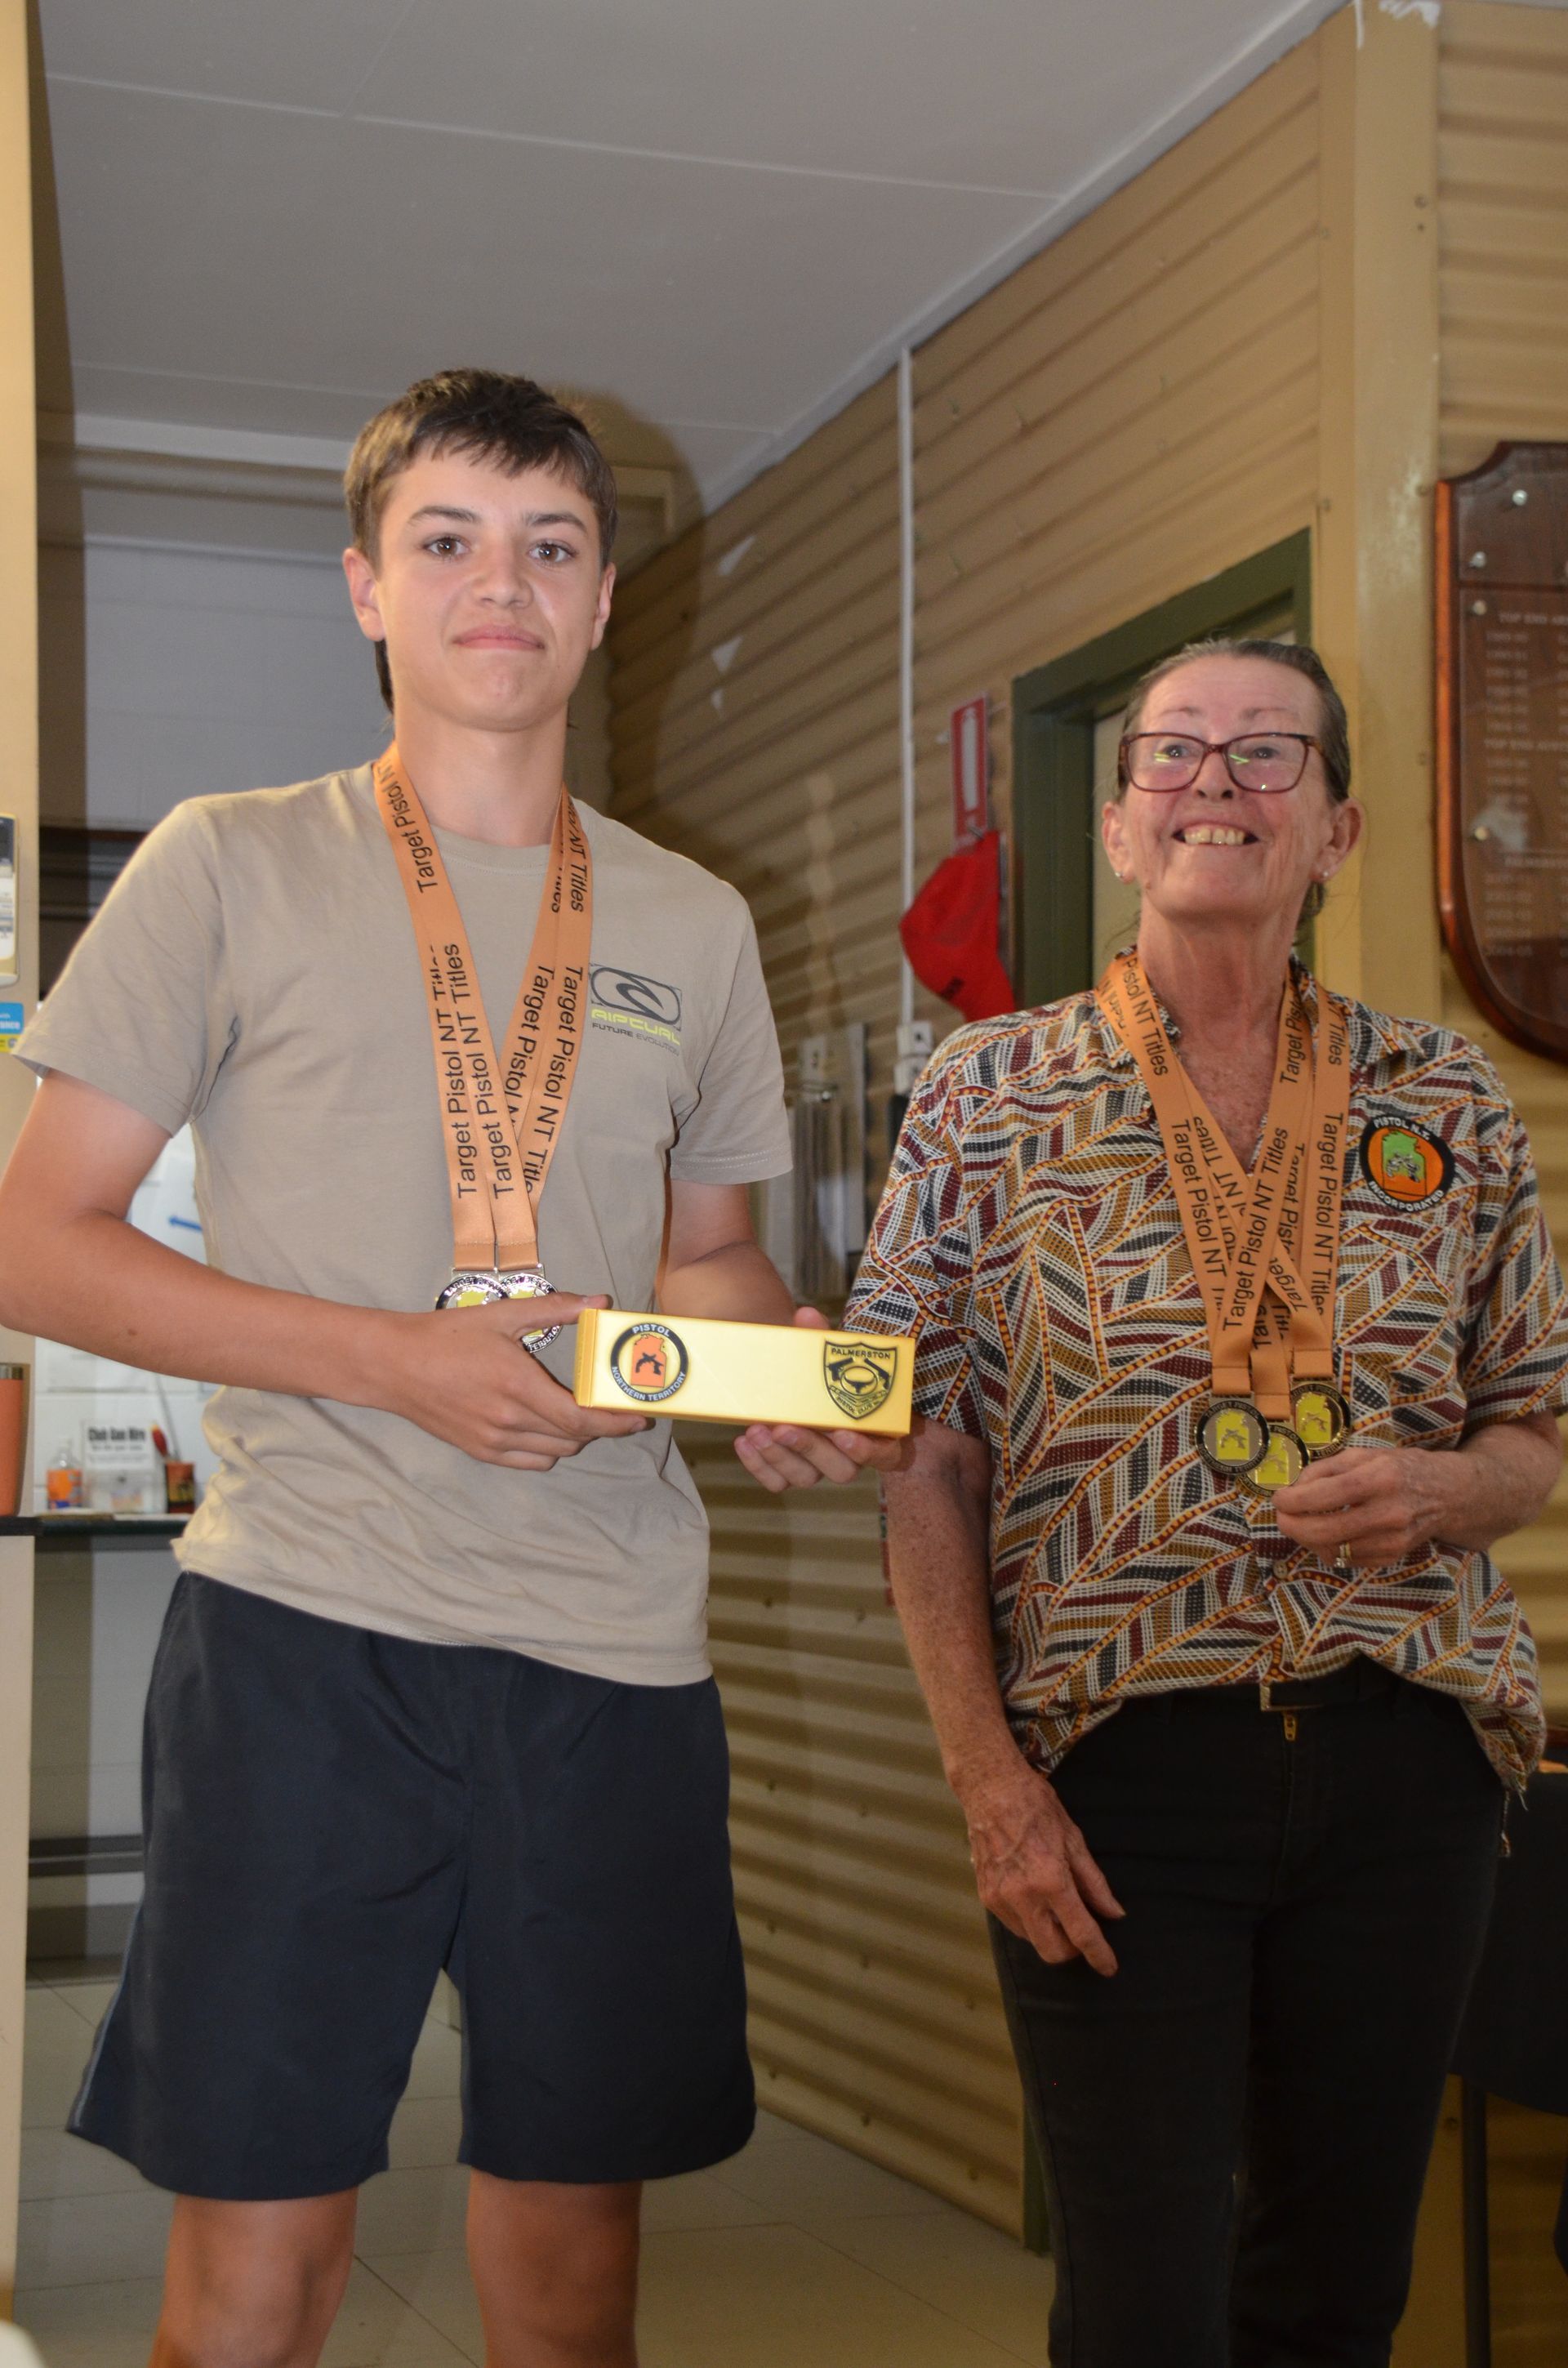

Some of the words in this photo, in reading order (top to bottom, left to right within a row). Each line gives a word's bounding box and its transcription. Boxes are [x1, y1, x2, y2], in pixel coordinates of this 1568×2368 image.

[381, 781, 416, 828] Pistol
[401, 829, 439, 894] Target
[570, 863, 587, 913] Titles
[444, 943, 470, 1004] Titles
[1123, 957, 1146, 1000] Pistol
[521, 965, 555, 1031] Target
[557, 966, 583, 1032] Target
[1132, 1000, 1156, 1023] NT
[436, 1008, 457, 1041] NT
[457, 1011, 481, 1044] NT
[591, 1008, 680, 1046] RIPCURL
[592, 1023, 634, 1037] FUTURE
[1328, 1023, 1346, 1066] Titles
[504, 1036, 537, 1098] Pistol
[543, 1038, 575, 1099] Pistol
[1142, 1028, 1169, 1077] Titles
[1280, 1033, 1306, 1085] Target
[442, 1051, 467, 1113] Pistol
[466, 1053, 497, 1115] Pistol
[534, 1105, 559, 1142] NT
[1317, 1113, 1343, 1172] Target
[1373, 1117, 1410, 1130] PISTOL
[451, 1122, 477, 1198] Target
[482, 1122, 514, 1199] Target
[1172, 1119, 1202, 1184] Target
[1261, 1128, 1288, 1174] Titles
[1213, 1172, 1243, 1197] NT
[1253, 1179, 1275, 1211] NT
[1316, 1176, 1338, 1229] Pistol
[1369, 1180, 1444, 1211] INCORPORATED
[1187, 1188, 1218, 1242] Pistol
[1277, 1207, 1298, 1254] Pist
[1202, 1249, 1227, 1277] NT
[1238, 1213, 1267, 1266] Pistol
[1313, 1233, 1334, 1263] NT
[1223, 1270, 1255, 1331] Target
[632, 1324, 670, 1336] PISTOL
[831, 1347, 891, 1359] PALMERSTON
[612, 1366, 645, 1401] NORTHERN
[648, 1371, 686, 1402] TERRITORY
